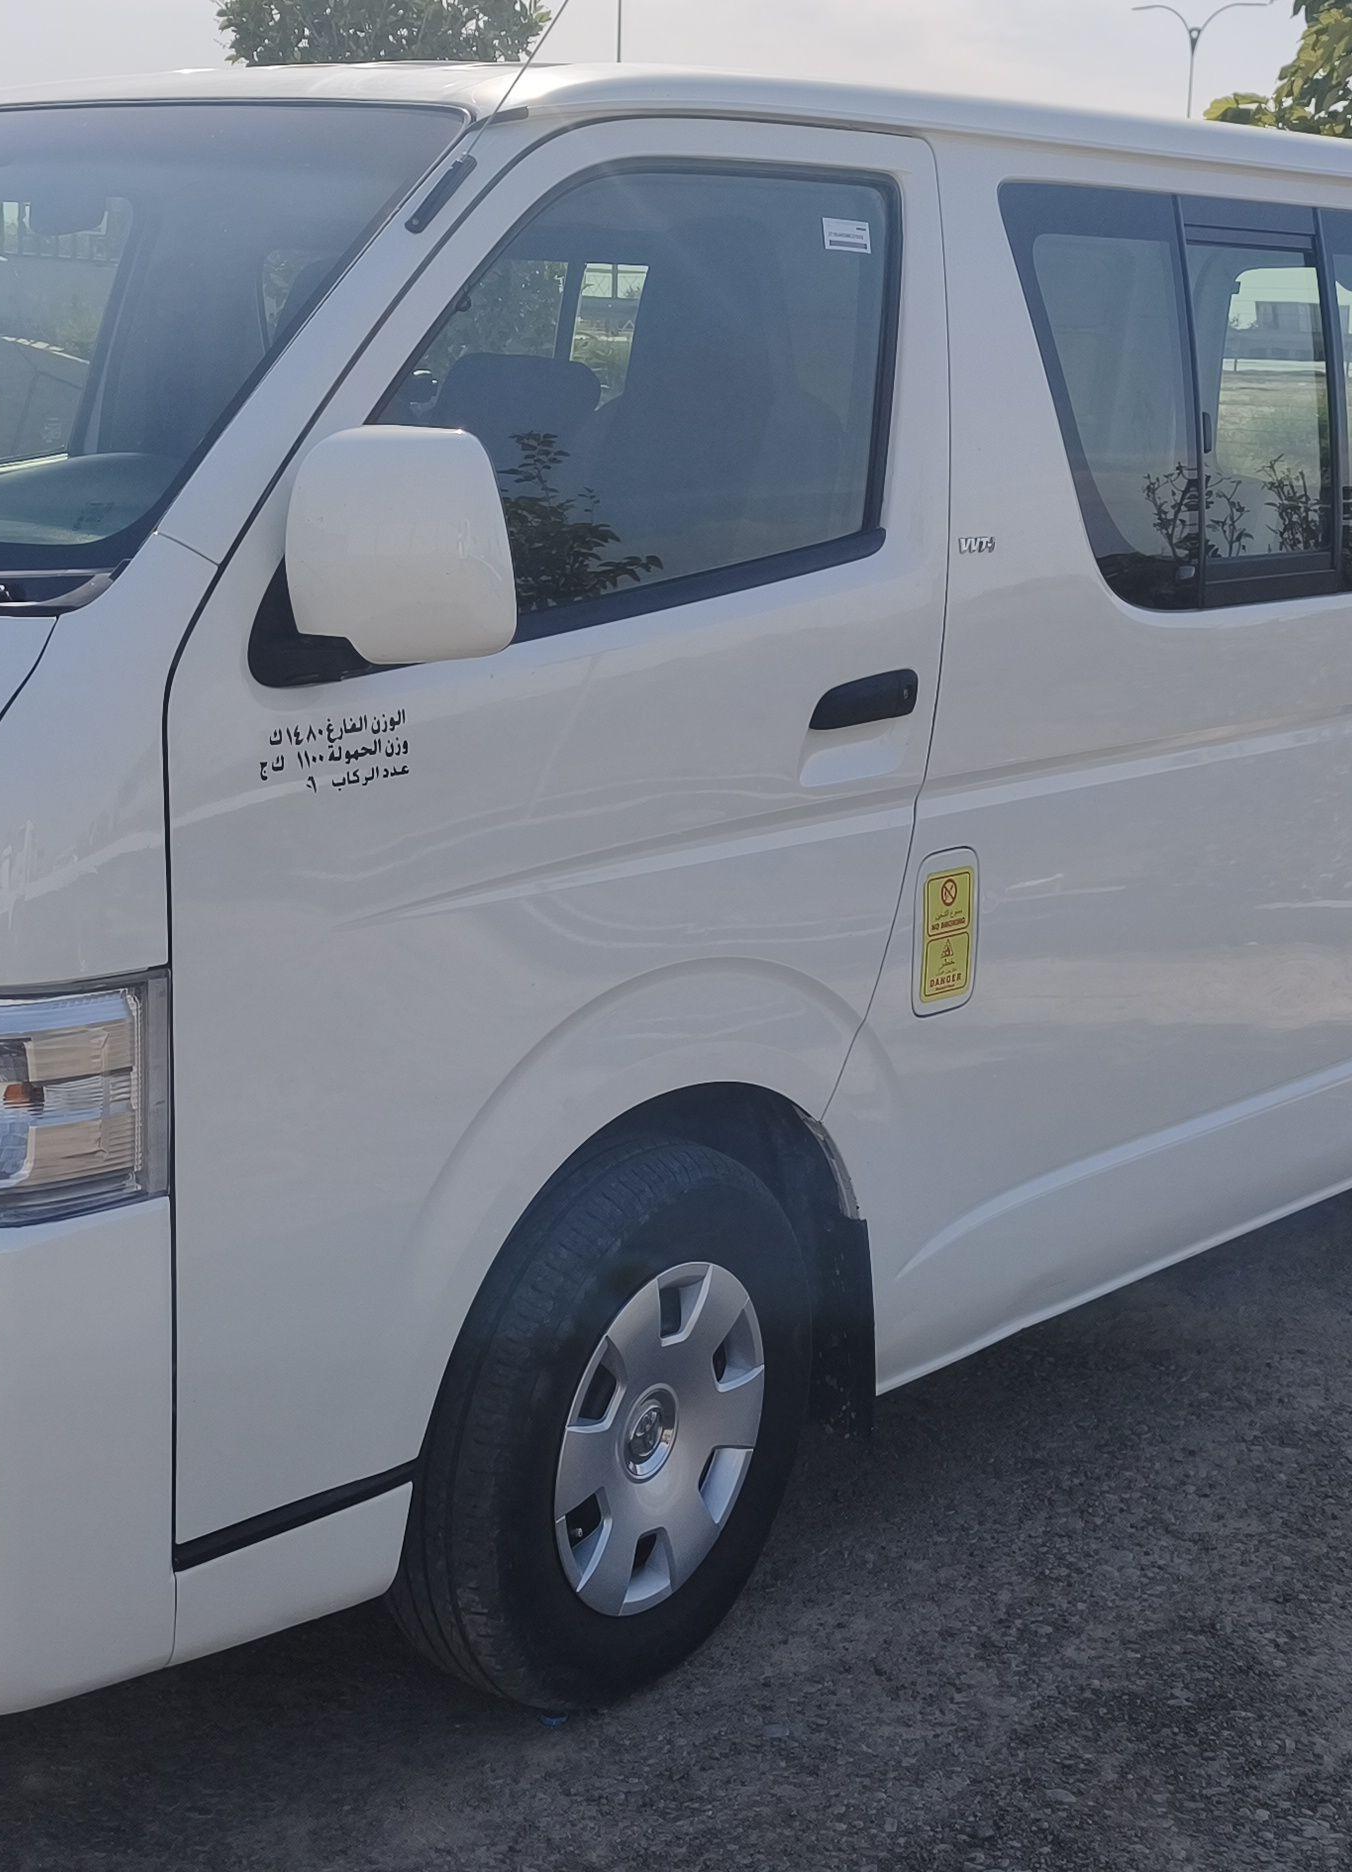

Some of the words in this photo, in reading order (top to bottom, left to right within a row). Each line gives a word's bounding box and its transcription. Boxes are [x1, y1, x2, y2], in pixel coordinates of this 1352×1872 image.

[326, 714, 368, 743] الفارغ
[371, 709, 405, 734] الوزن
[328, 738, 382, 764] الحمولة
[385, 737, 409, 757] وزن
[331, 766, 379, 791] الركاب
[383, 764, 409, 778] عدد
